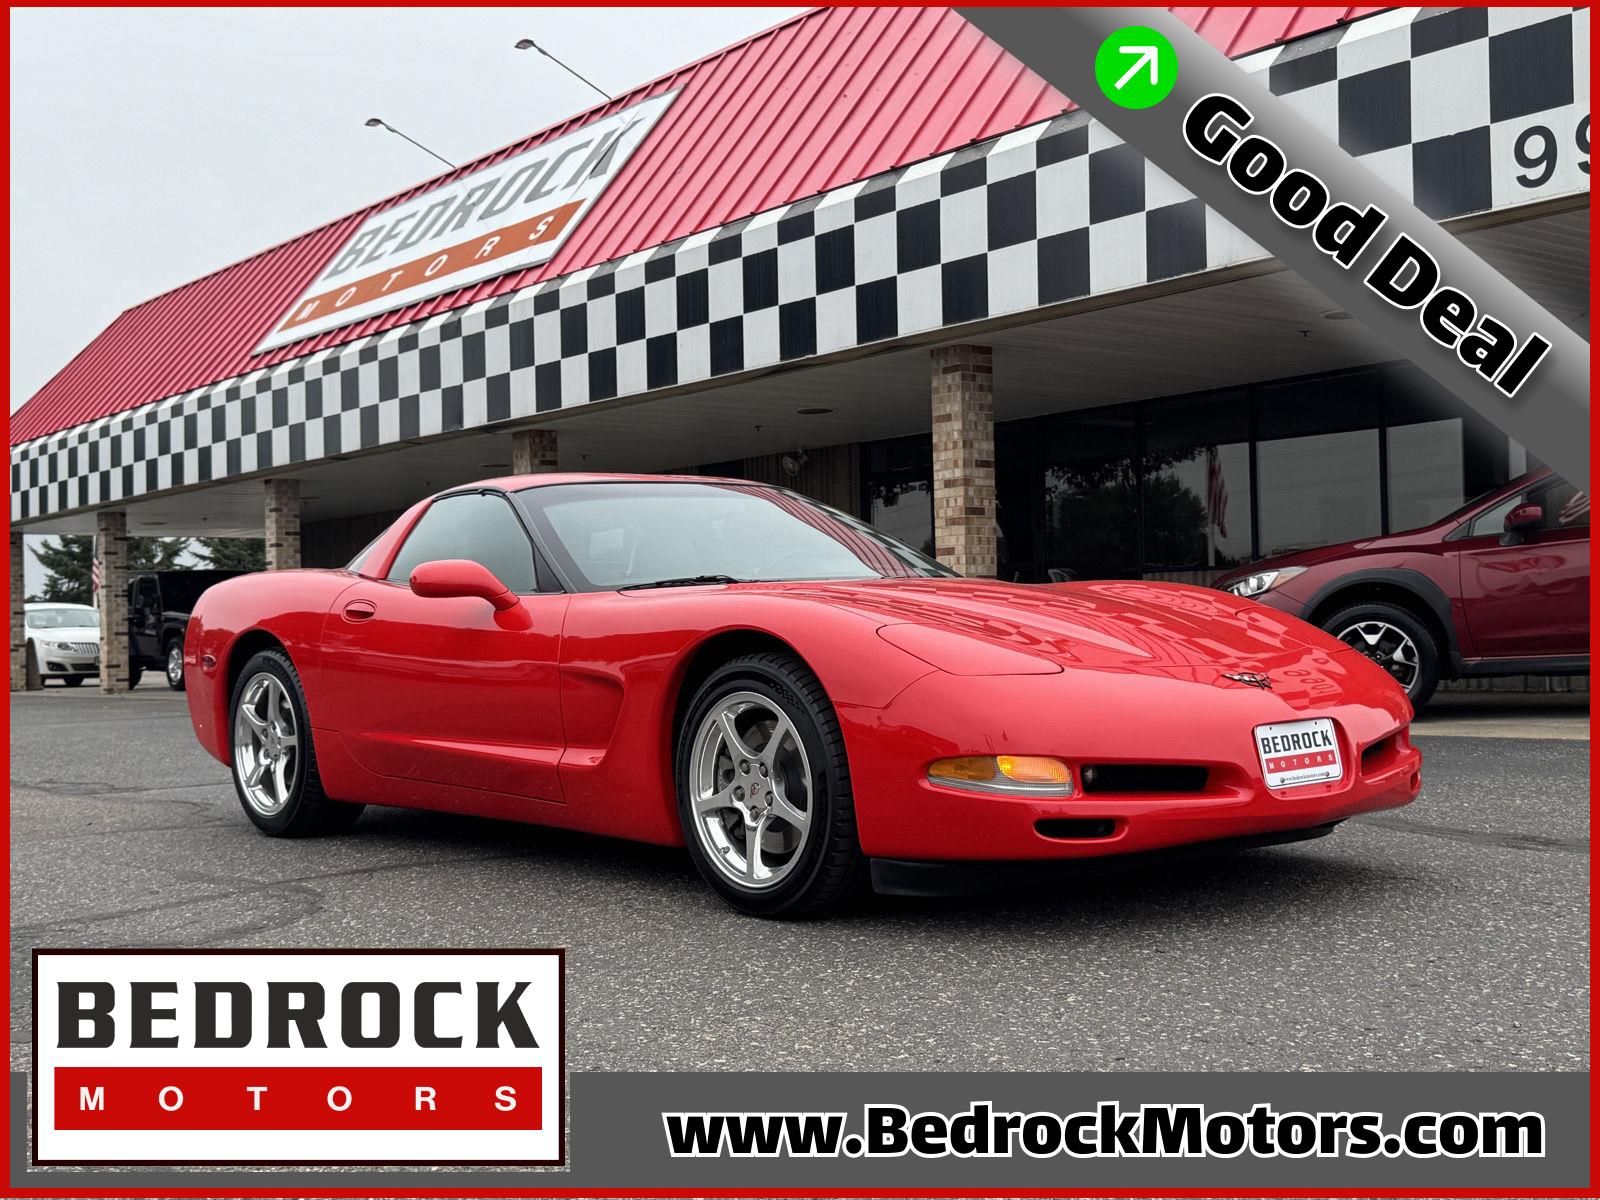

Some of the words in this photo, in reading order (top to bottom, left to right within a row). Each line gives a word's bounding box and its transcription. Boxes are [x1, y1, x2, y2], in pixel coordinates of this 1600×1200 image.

[323, 116, 647, 280] BEDROCK
[296, 215, 554, 321] MOTORS
[1260, 729, 1332, 754] BEDROCK
[1269, 753, 1333, 769] MOTORS
